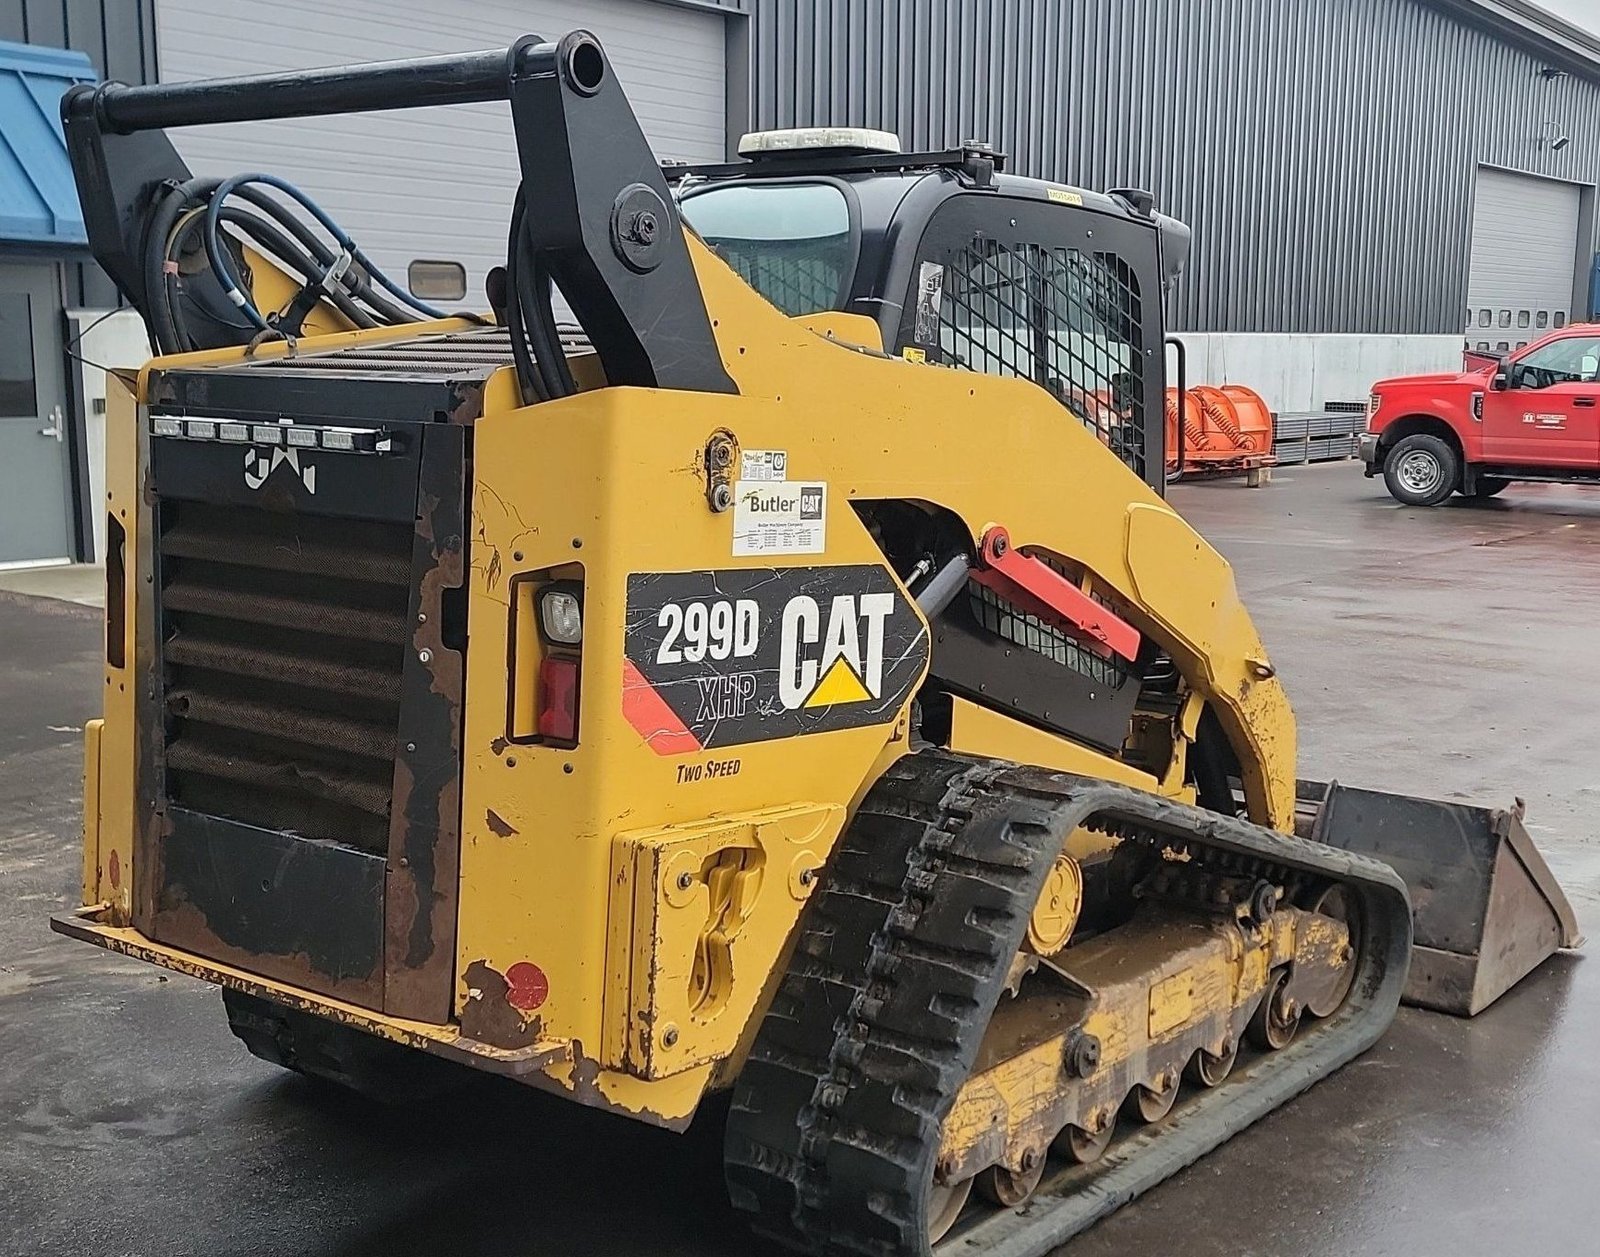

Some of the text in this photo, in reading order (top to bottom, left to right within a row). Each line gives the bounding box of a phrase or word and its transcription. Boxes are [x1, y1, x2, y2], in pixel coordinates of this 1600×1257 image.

[750, 496, 796, 512] Butler
[801, 494, 822, 512] CAT
[657, 599, 760, 665] 299D
[779, 592, 895, 710] CAT
[696, 674, 757, 722] XHP
